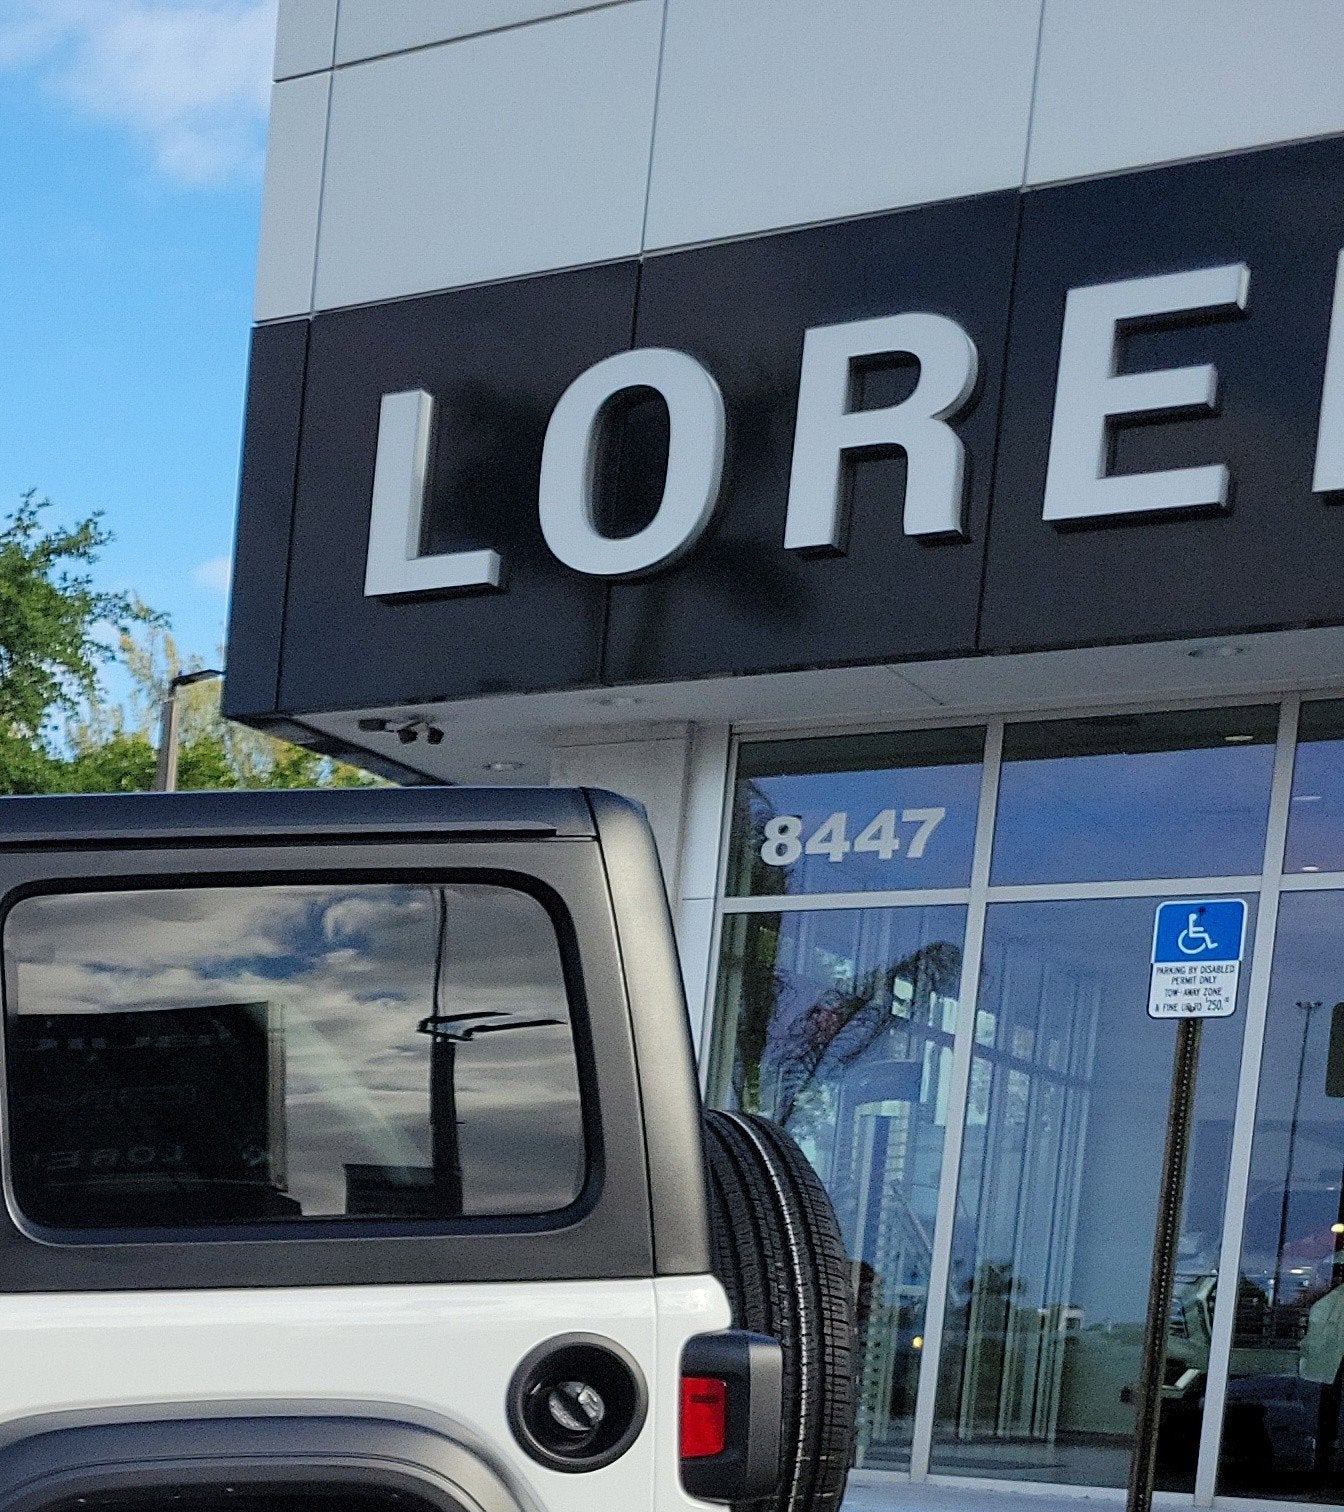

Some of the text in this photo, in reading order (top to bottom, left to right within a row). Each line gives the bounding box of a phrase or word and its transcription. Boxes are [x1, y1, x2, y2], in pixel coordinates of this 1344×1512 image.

[364, 240, 1344, 599] LORE
[760, 807, 946, 867] 8447
[1156, 964, 1235, 975] PARKING BY DISABLED
[1171, 975, 1217, 985] PERMIT ONLY
[1203, 987, 1222, 997] ZONE
[1162, 1002, 1178, 1012] FINE
